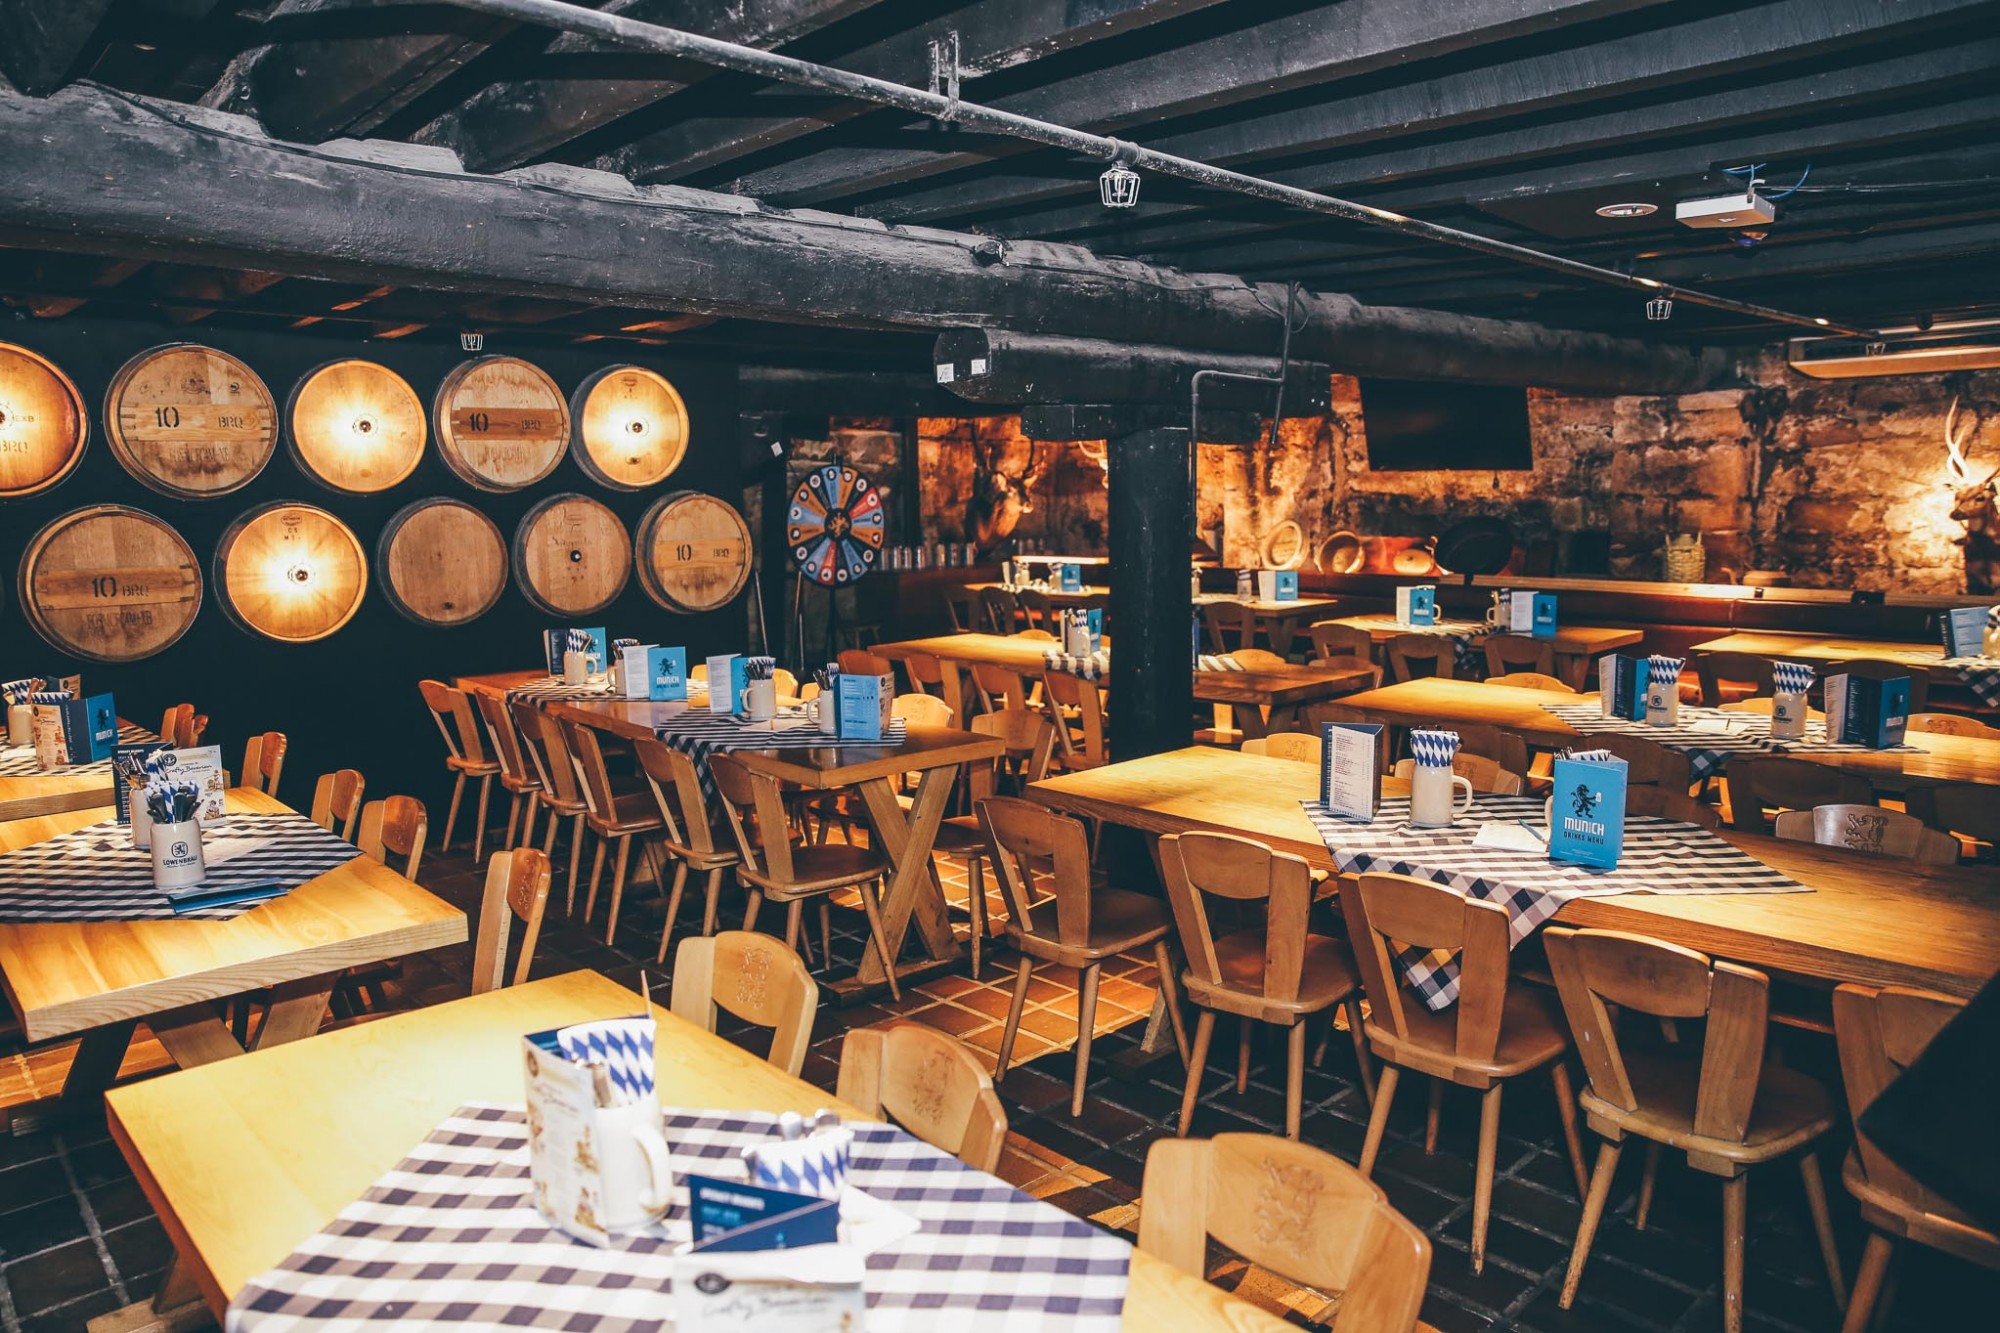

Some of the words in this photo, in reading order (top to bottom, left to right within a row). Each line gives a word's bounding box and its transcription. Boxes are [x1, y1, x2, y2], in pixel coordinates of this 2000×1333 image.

[155, 406, 180, 428] 10
[469, 412, 489, 432] 10
[676, 544, 692, 561] 10
[92, 576, 117, 598] 10
[1564, 816, 1605, 836] MUNICH
[1563, 831, 1585, 841] DRINKS
[1587, 835, 1604, 845] MENU
